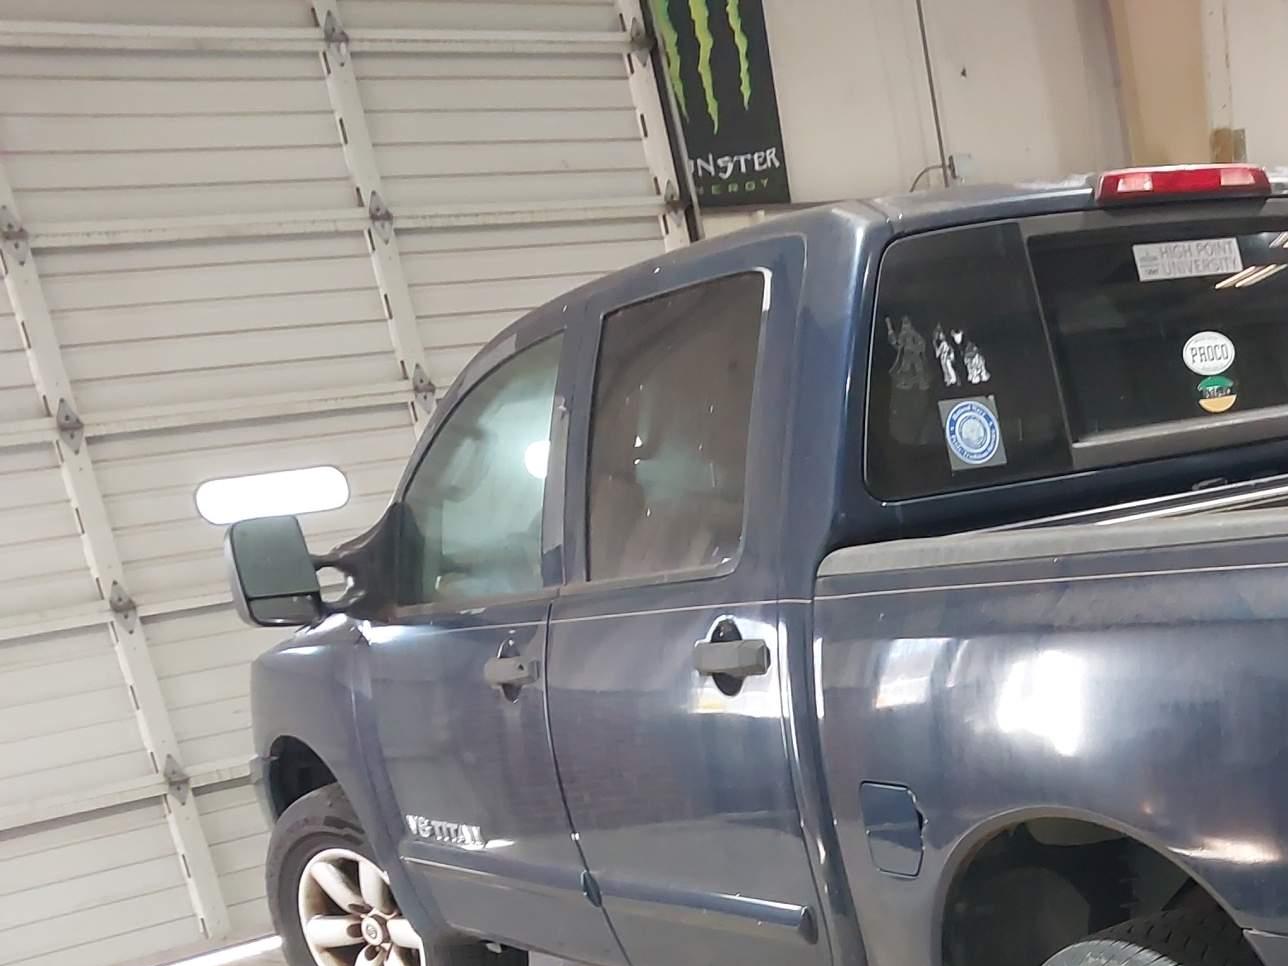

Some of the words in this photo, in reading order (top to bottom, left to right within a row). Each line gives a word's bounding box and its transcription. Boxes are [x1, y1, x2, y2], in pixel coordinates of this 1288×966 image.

[1160, 243, 1193, 260] HIGH
[1196, 240, 1234, 257] POINT
[1160, 256, 1239, 276] UNIVERSITY
[1190, 343, 1229, 363] PROCO
[431, 820, 484, 845] TITAN
